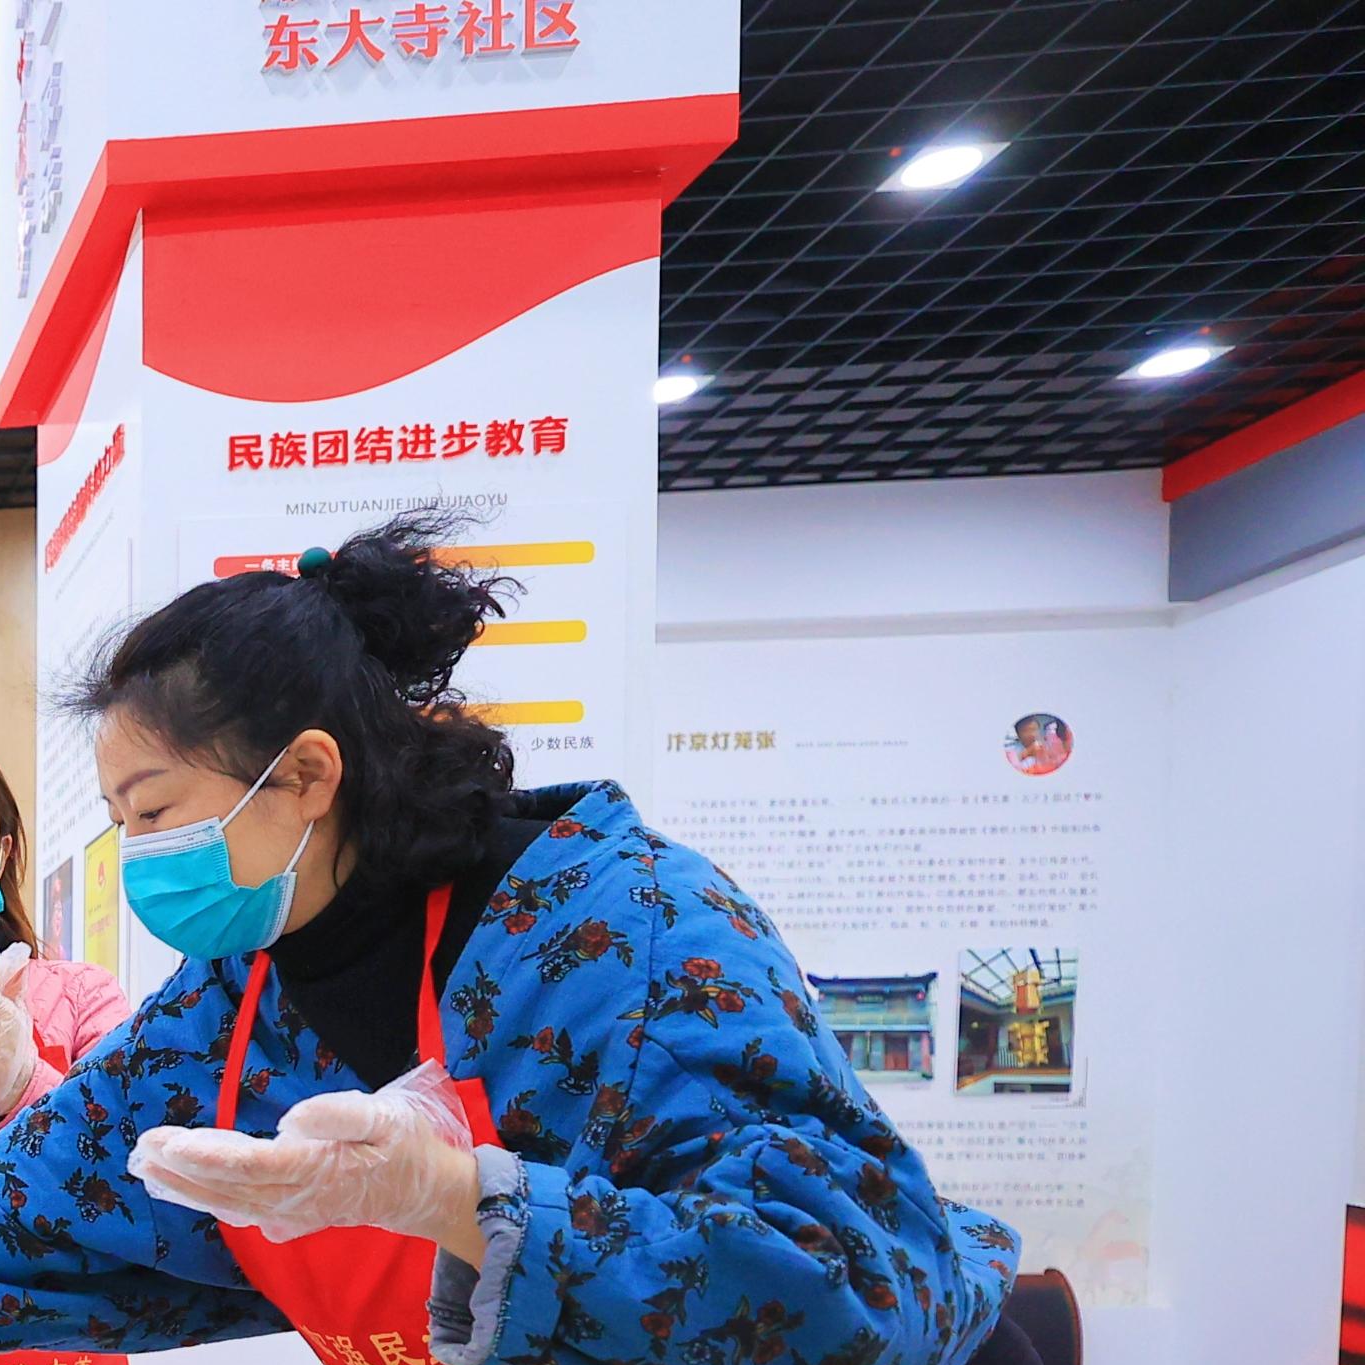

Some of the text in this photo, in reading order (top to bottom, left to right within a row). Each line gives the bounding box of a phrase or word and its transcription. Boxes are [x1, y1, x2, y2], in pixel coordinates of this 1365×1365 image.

[263, 0, 581, 70] 东大寺社区
[227, 415, 570, 471] 民族团结进步教育
[285, 493, 509, 517] MINZUTUANJIEJINBUJIAOYU
